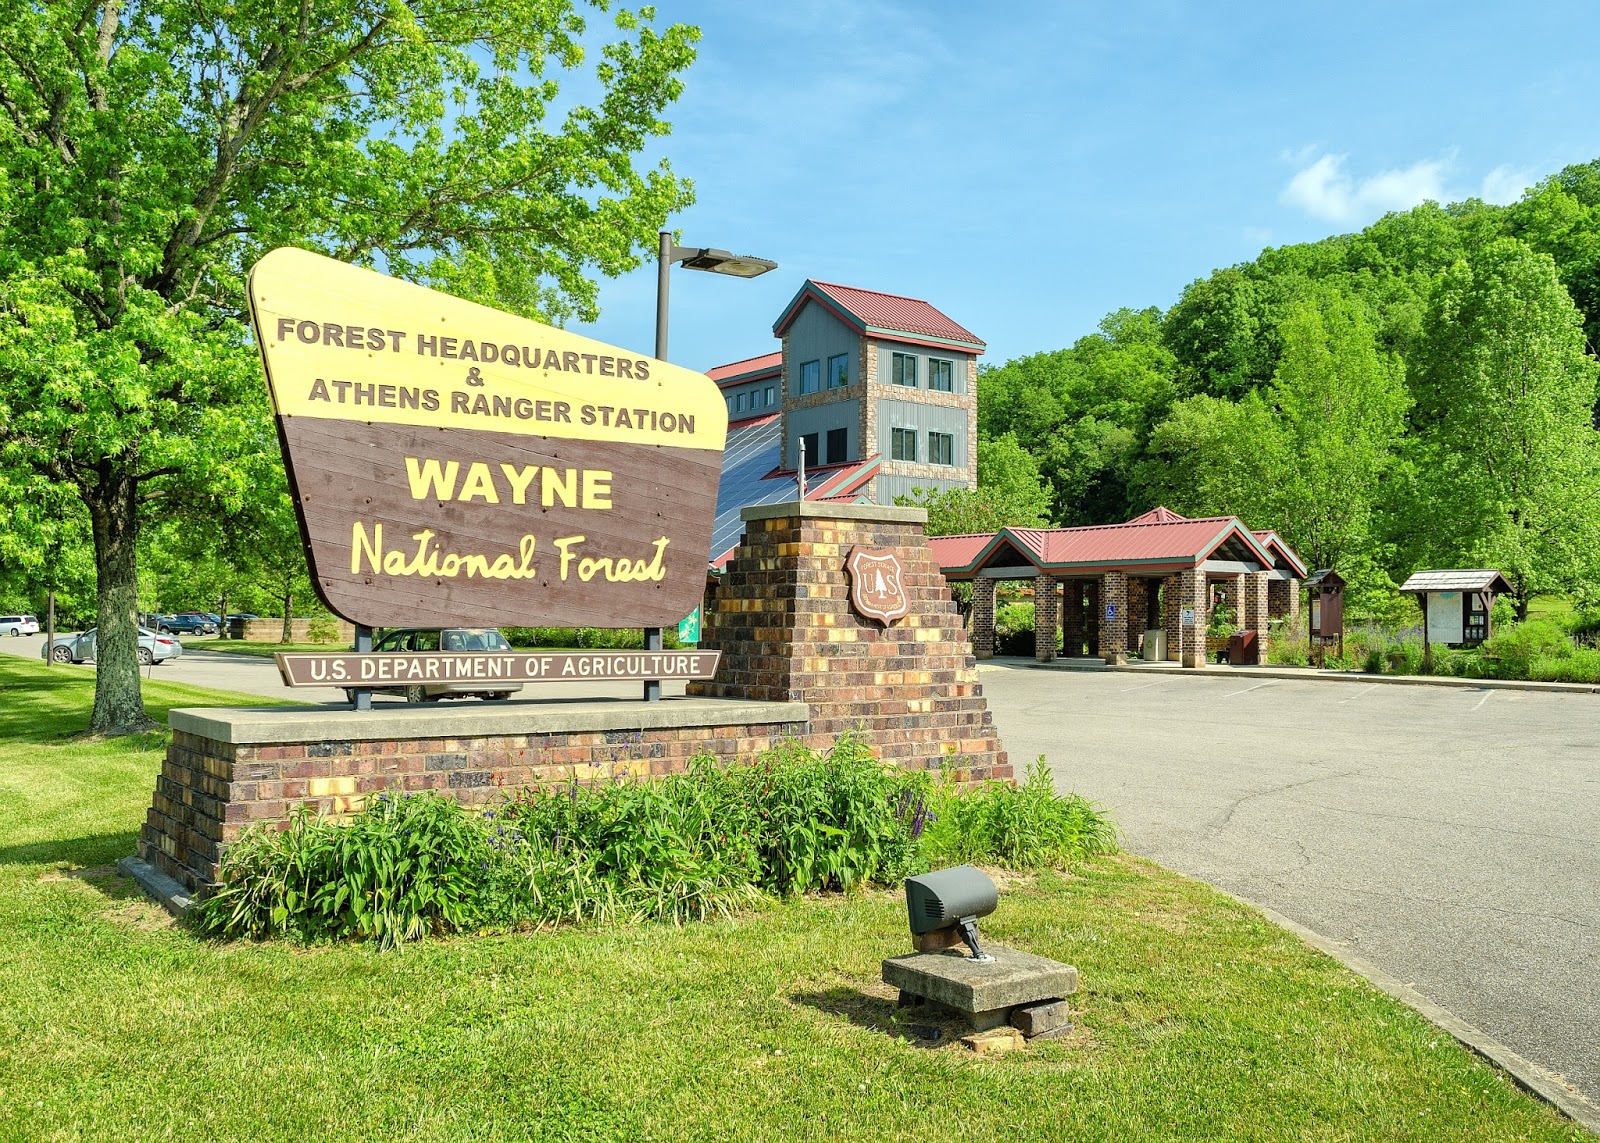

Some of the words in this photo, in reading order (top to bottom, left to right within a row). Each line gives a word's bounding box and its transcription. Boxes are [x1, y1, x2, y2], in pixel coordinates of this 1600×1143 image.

[277, 318, 407, 353] FOREST
[417, 333, 650, 381] HEADQUARTERS
[465, 366, 485, 387] &
[307, 378, 440, 412] ATHENS
[451, 391, 572, 424] RANGER
[580, 404, 695, 435] STATION
[404, 457, 613, 510] WAYNE
[350, 521, 536, 579] National
[554, 535, 669, 582] Forest
[310, 659, 352, 681] U.S.
[361, 657, 516, 679] DEPARTMENT
[525, 657, 553, 677] OF
[561, 655, 701, 676] AGRICULTURE
